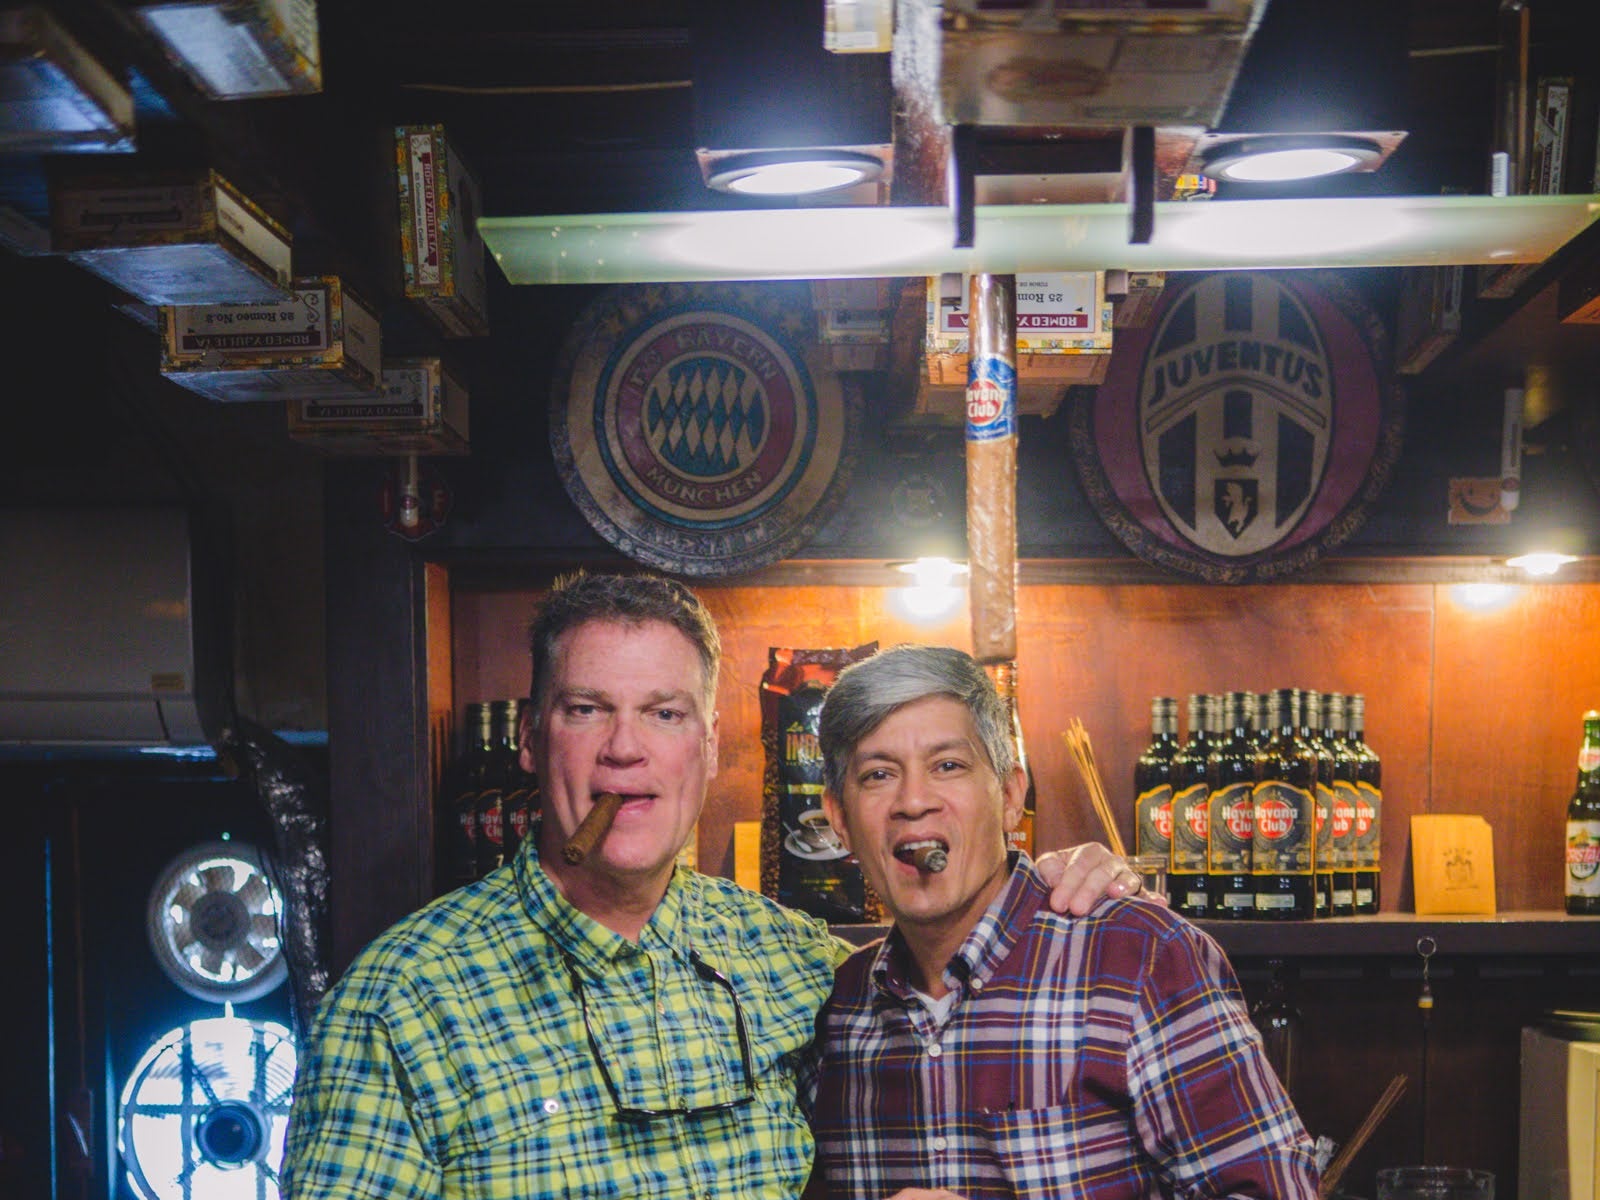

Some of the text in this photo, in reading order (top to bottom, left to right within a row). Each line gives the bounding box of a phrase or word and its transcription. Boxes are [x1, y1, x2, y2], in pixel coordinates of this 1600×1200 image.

[1048, 294, 1063, 303] 25
[236, 312, 277, 322] Romeo
[280, 312, 295, 322] 25
[1032, 316, 1077, 326] ROMEO
[195, 335, 253, 346] JULIETA
[264, 335, 310, 345] ROMEO
[1147, 341, 1323, 408] JUVENTUS
[968, 402, 996, 418] Club
[1254, 805, 1298, 819] Havana
[1260, 819, 1287, 833] Club
